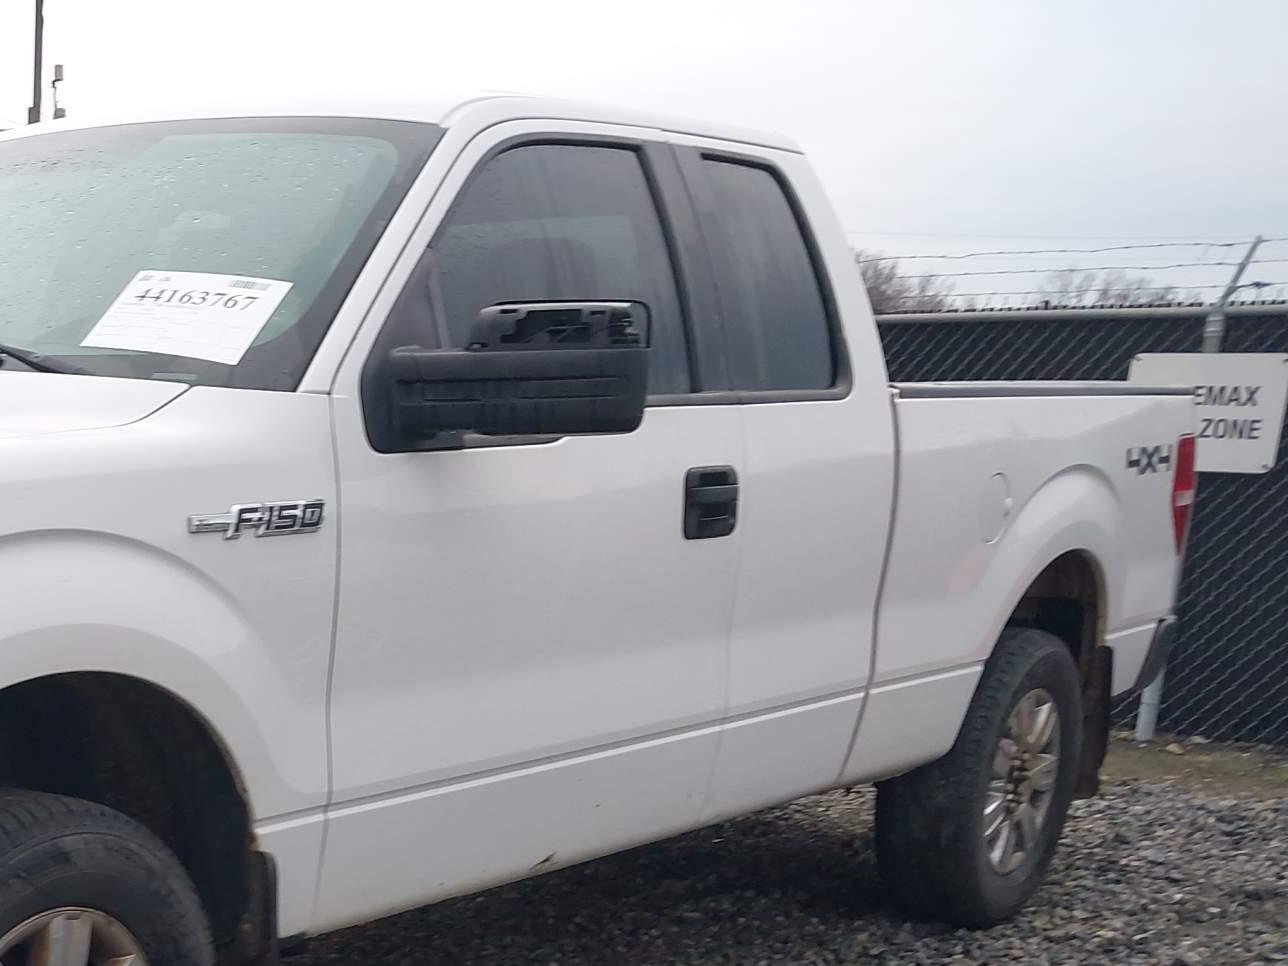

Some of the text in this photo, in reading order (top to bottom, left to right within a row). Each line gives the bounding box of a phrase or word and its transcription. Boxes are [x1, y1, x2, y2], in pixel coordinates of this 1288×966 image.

[134, 287, 259, 311] 44163767
[1193, 385, 1262, 407] EMAX
[1197, 417, 1264, 440] ZONE
